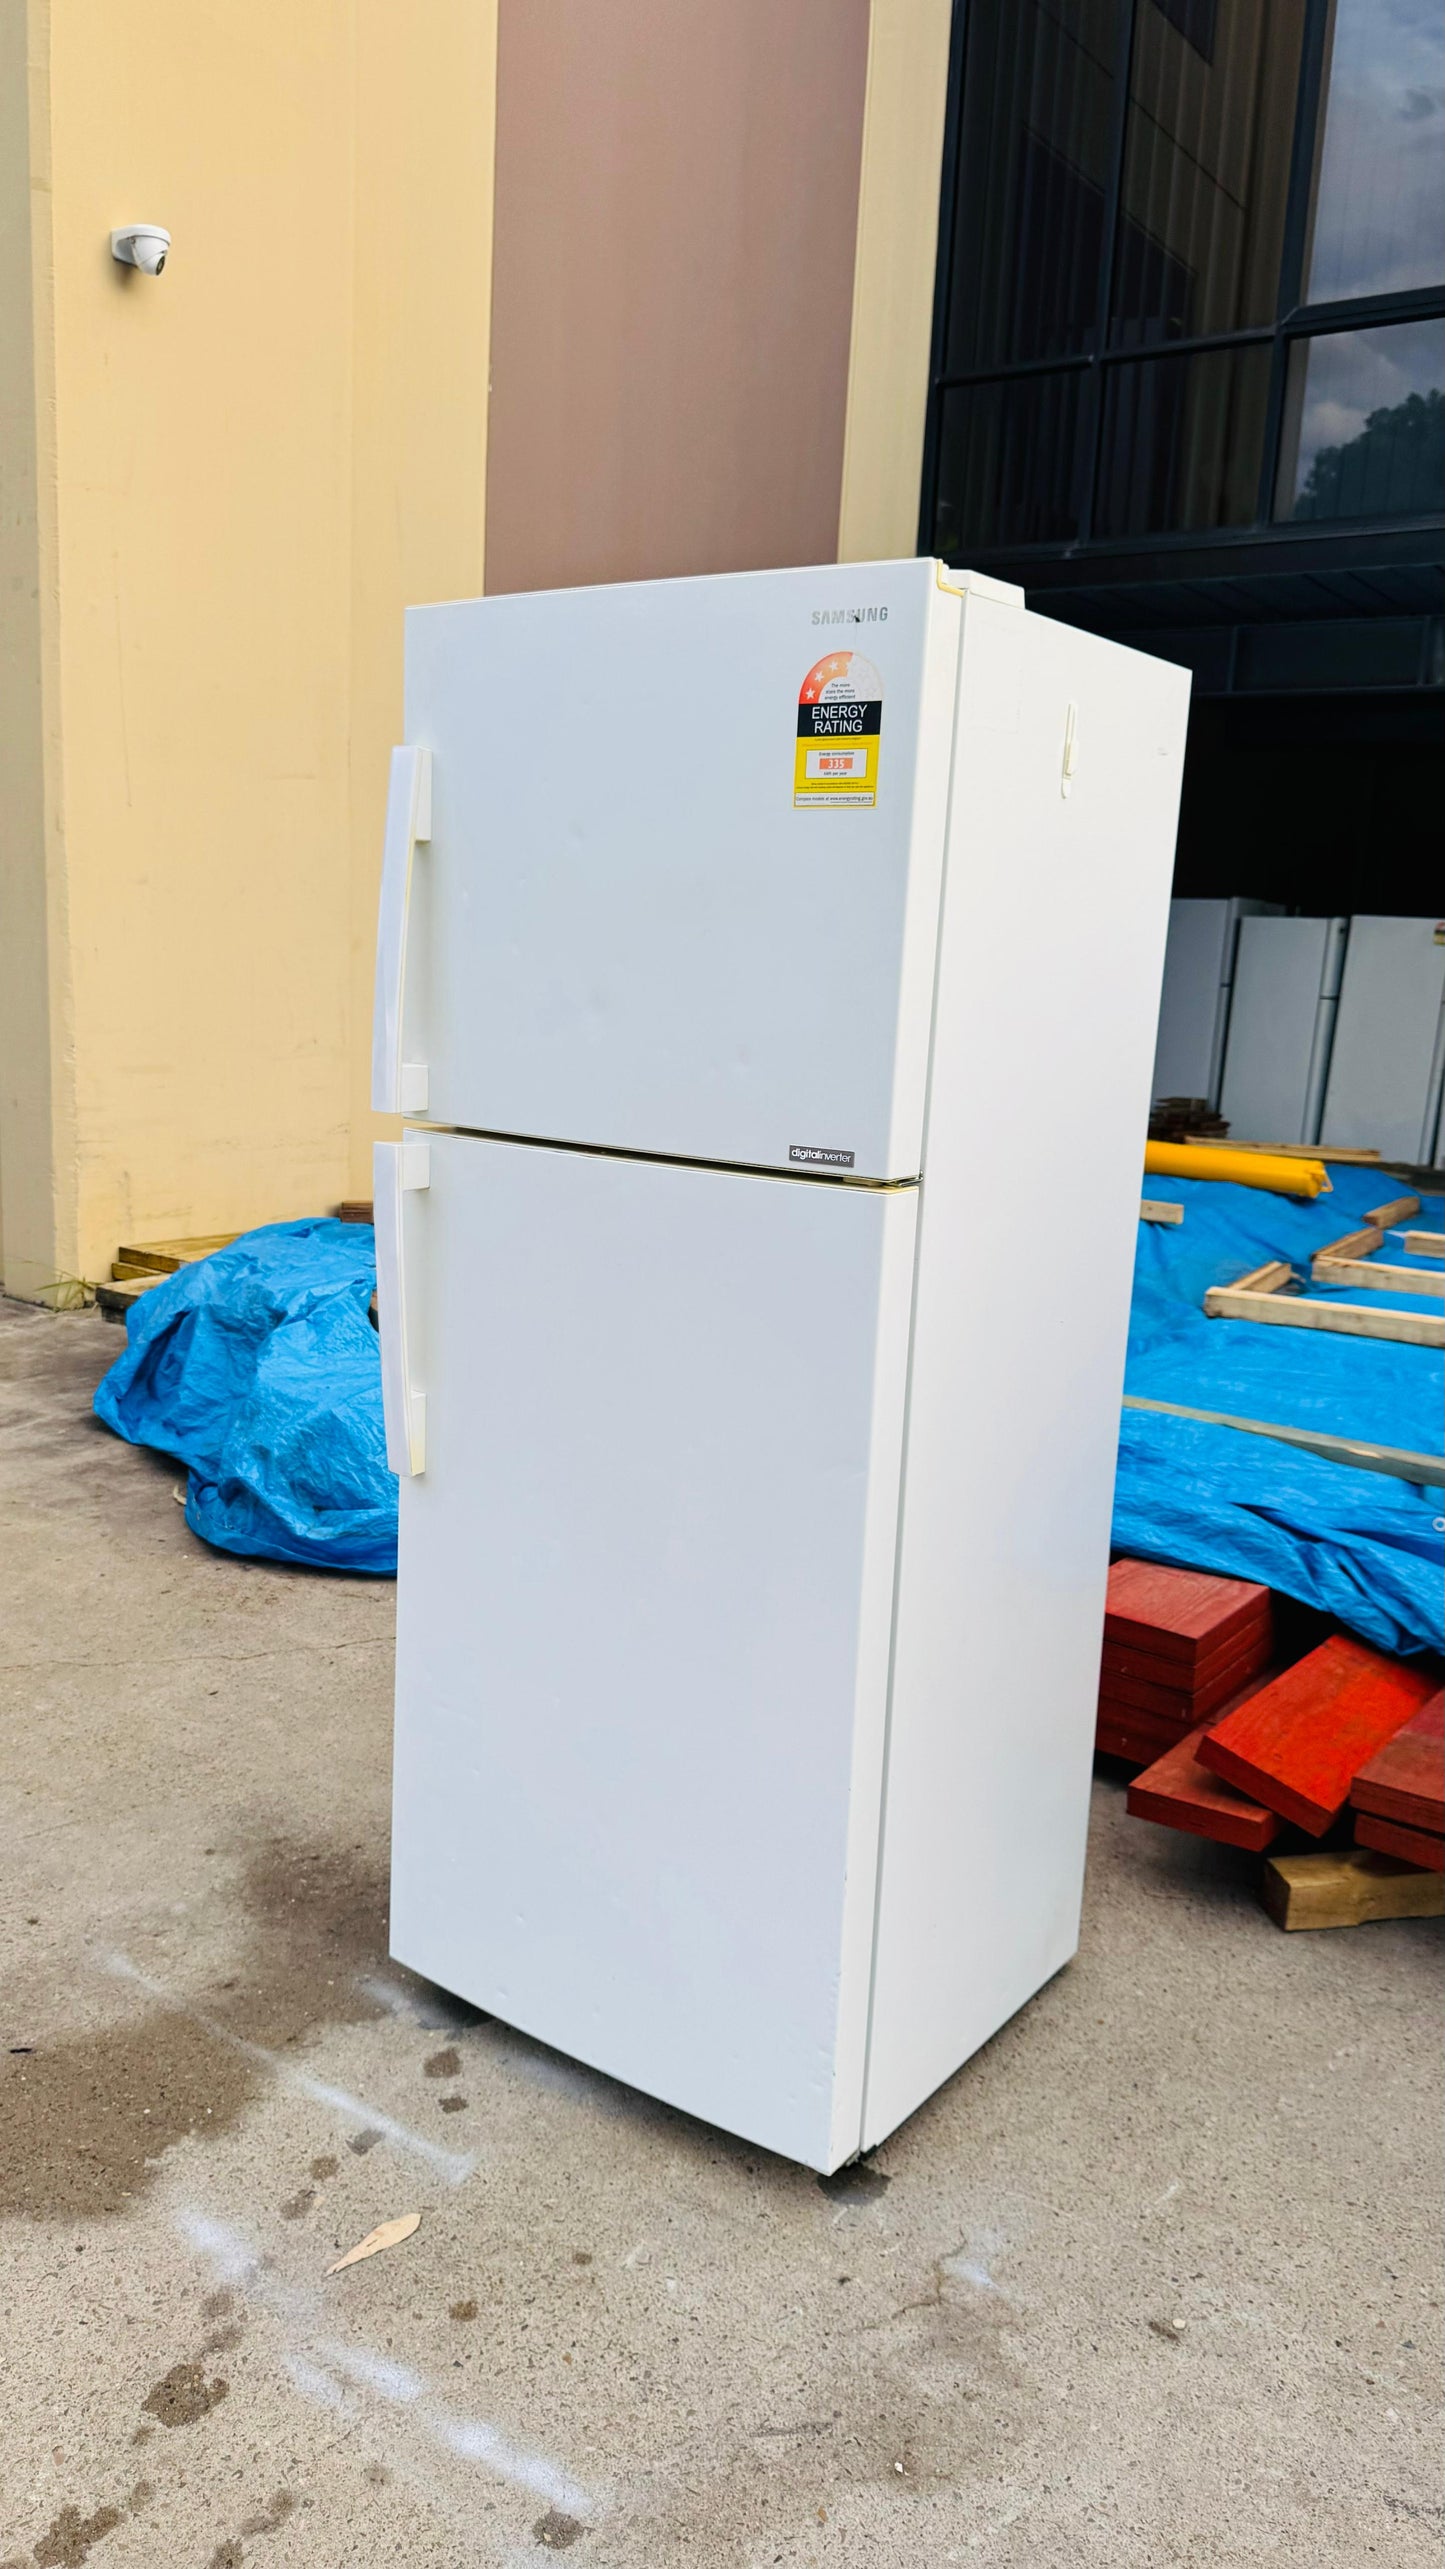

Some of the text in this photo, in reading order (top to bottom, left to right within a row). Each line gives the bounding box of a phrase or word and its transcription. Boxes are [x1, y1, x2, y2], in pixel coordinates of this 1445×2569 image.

[811, 606, 888, 625] SAMSUNG
[812, 704, 868, 719] ENERGY
[814, 719, 862, 734] RATING
[827, 759, 845, 769] 335
